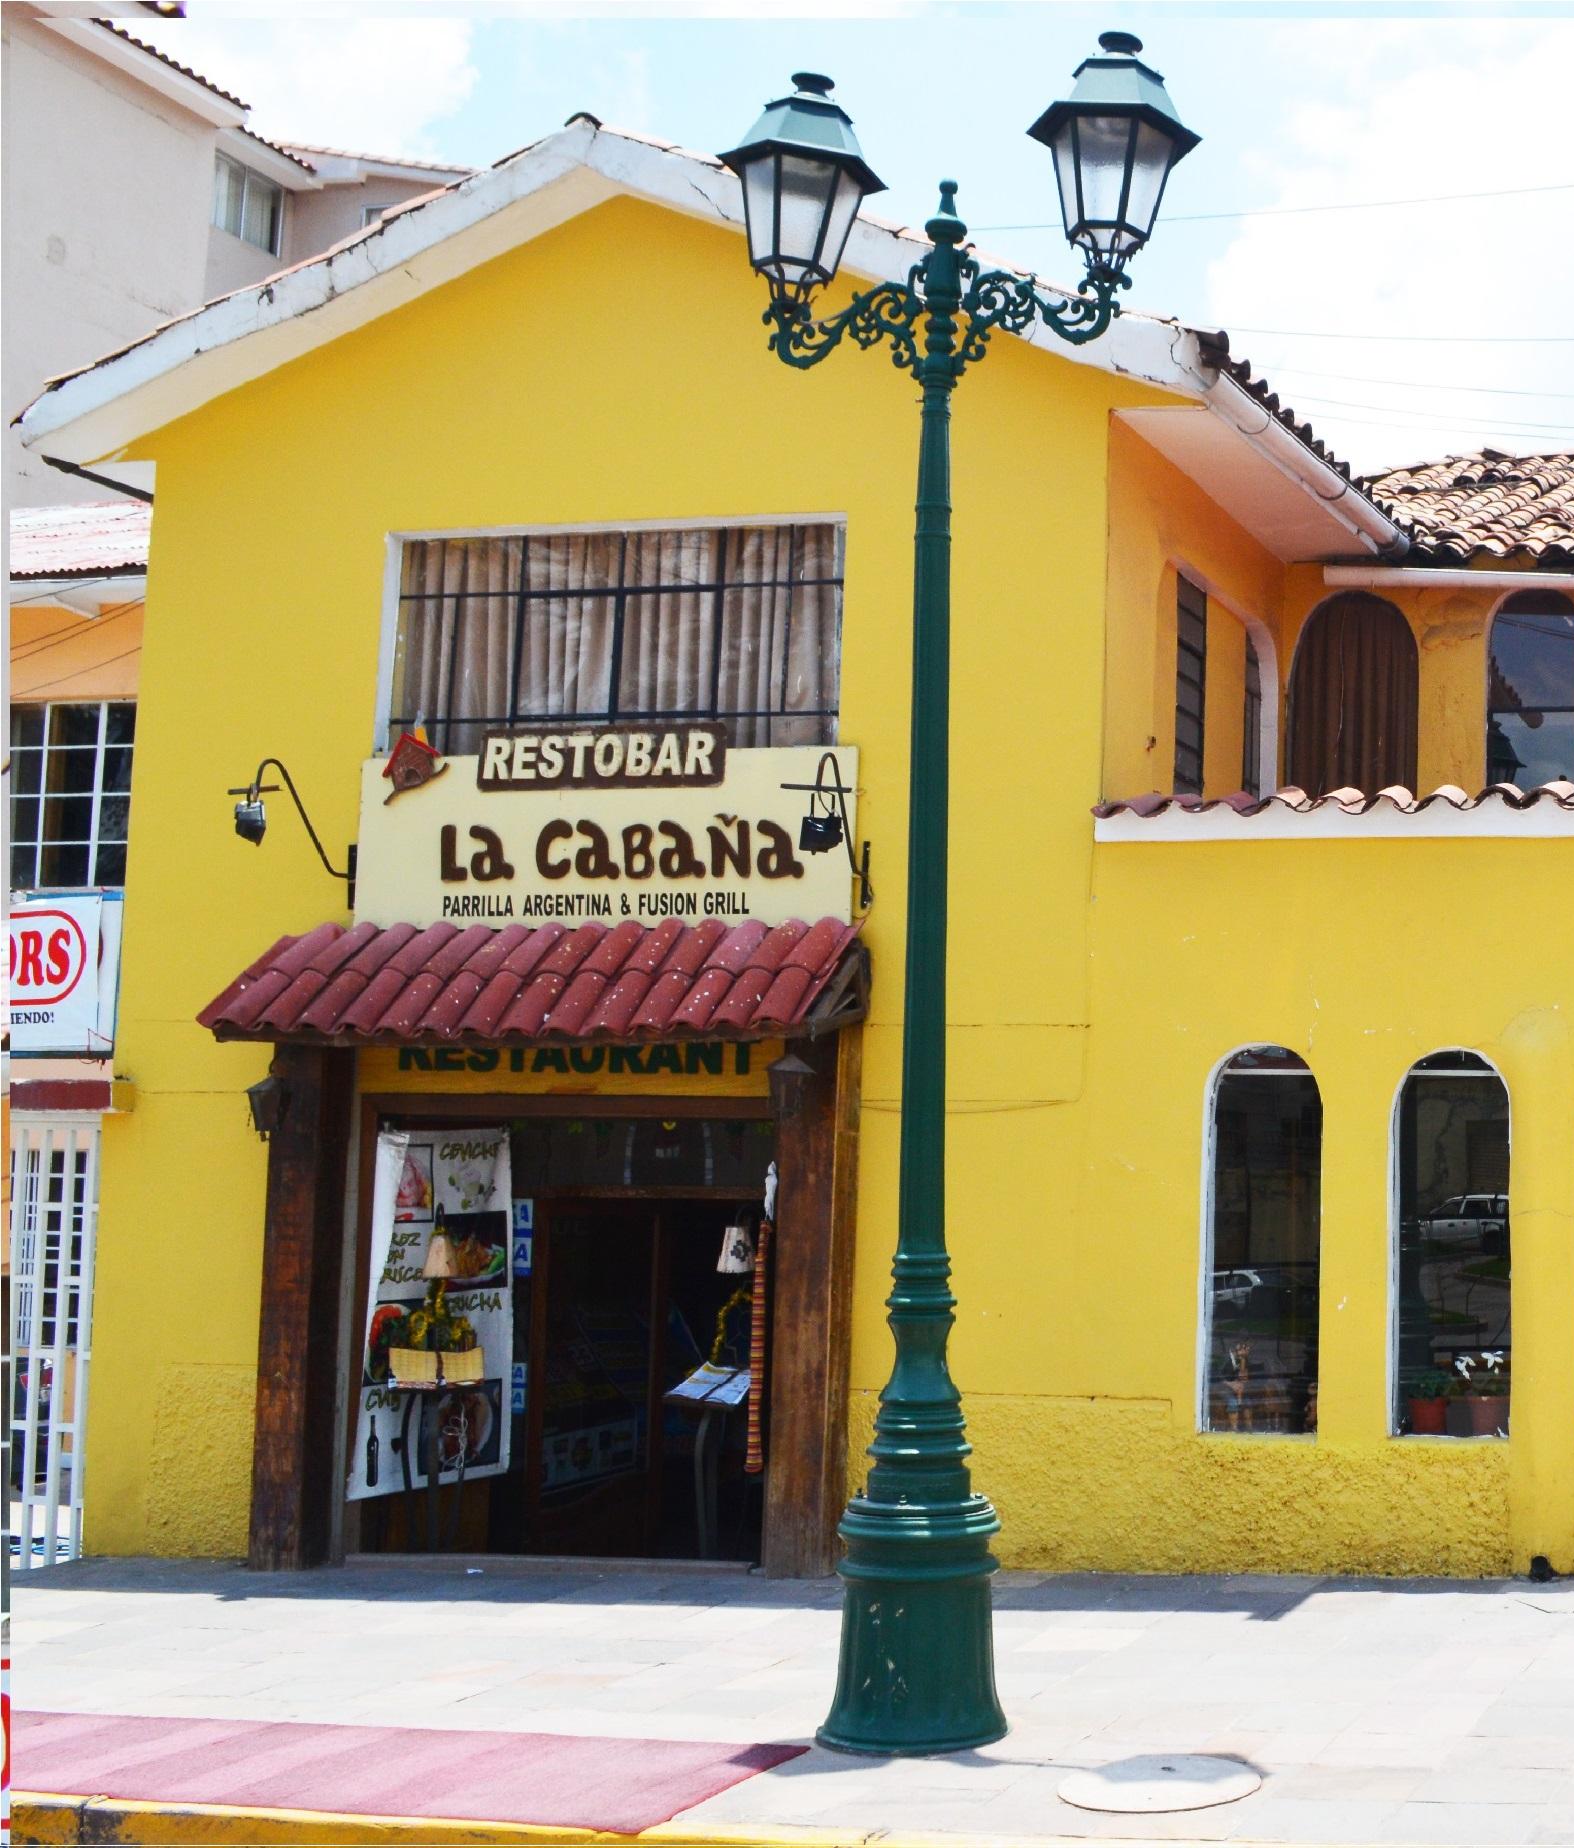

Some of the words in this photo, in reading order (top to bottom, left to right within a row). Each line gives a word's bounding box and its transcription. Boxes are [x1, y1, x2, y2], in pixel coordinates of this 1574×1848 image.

[483, 731, 715, 781] RESTOBAR
[442, 894, 514, 918] PARRILLA
[523, 893, 612, 917] ARGENTINA
[620, 894, 632, 916] &
[638, 893, 697, 917] FUSION
[703, 892, 750, 915] GRILL
[10, 928, 71, 985] RS
[398, 1041, 756, 1075] RESTAURANT
